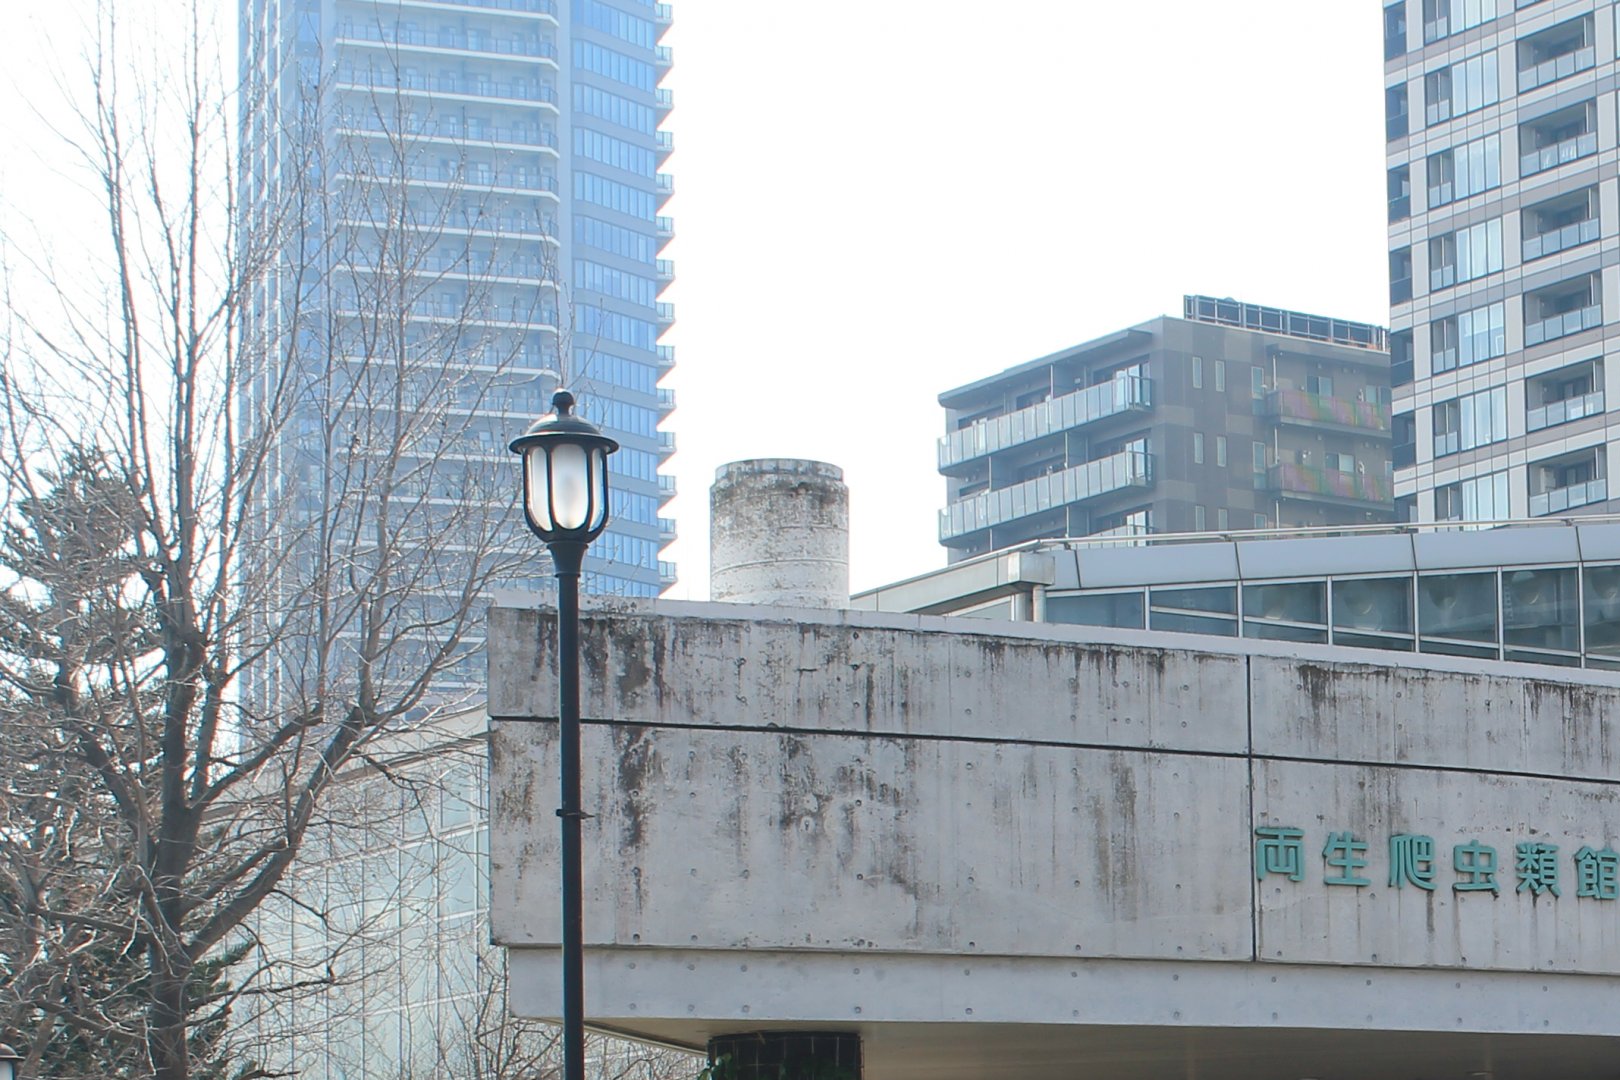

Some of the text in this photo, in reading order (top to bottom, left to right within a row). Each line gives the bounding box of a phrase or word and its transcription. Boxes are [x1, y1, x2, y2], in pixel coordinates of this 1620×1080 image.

[1256, 827, 1620, 900] 両生爬虫類館
